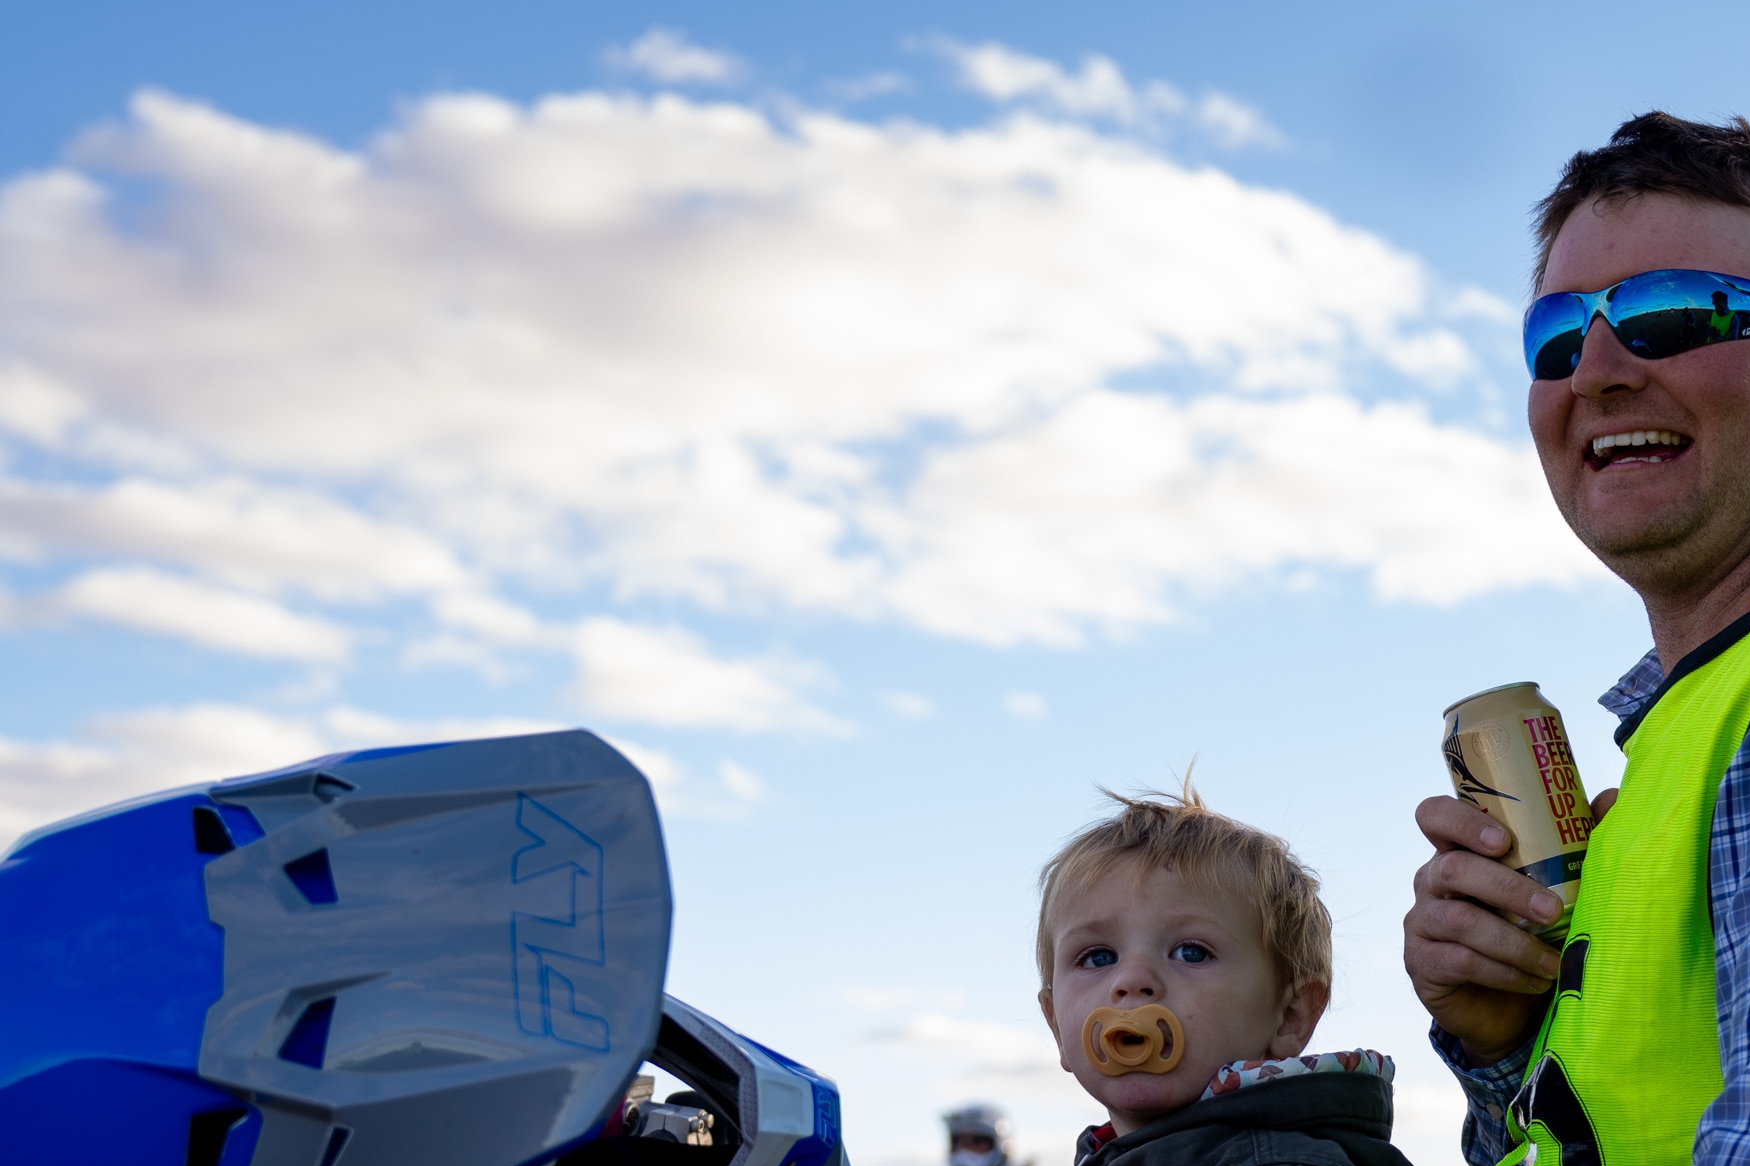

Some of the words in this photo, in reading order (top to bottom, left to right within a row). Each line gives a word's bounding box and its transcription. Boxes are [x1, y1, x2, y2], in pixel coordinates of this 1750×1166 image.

[1523, 716, 1562, 743] THE
[1532, 742, 1577, 769] BEER
[1539, 767, 1578, 795] FOR
[1547, 792, 1576, 819] UP
[1556, 817, 1596, 846] HER
[1567, 859, 1583, 872] GRE
[511, 791, 611, 1053] FLY
[818, 1088, 838, 1150] FLY
